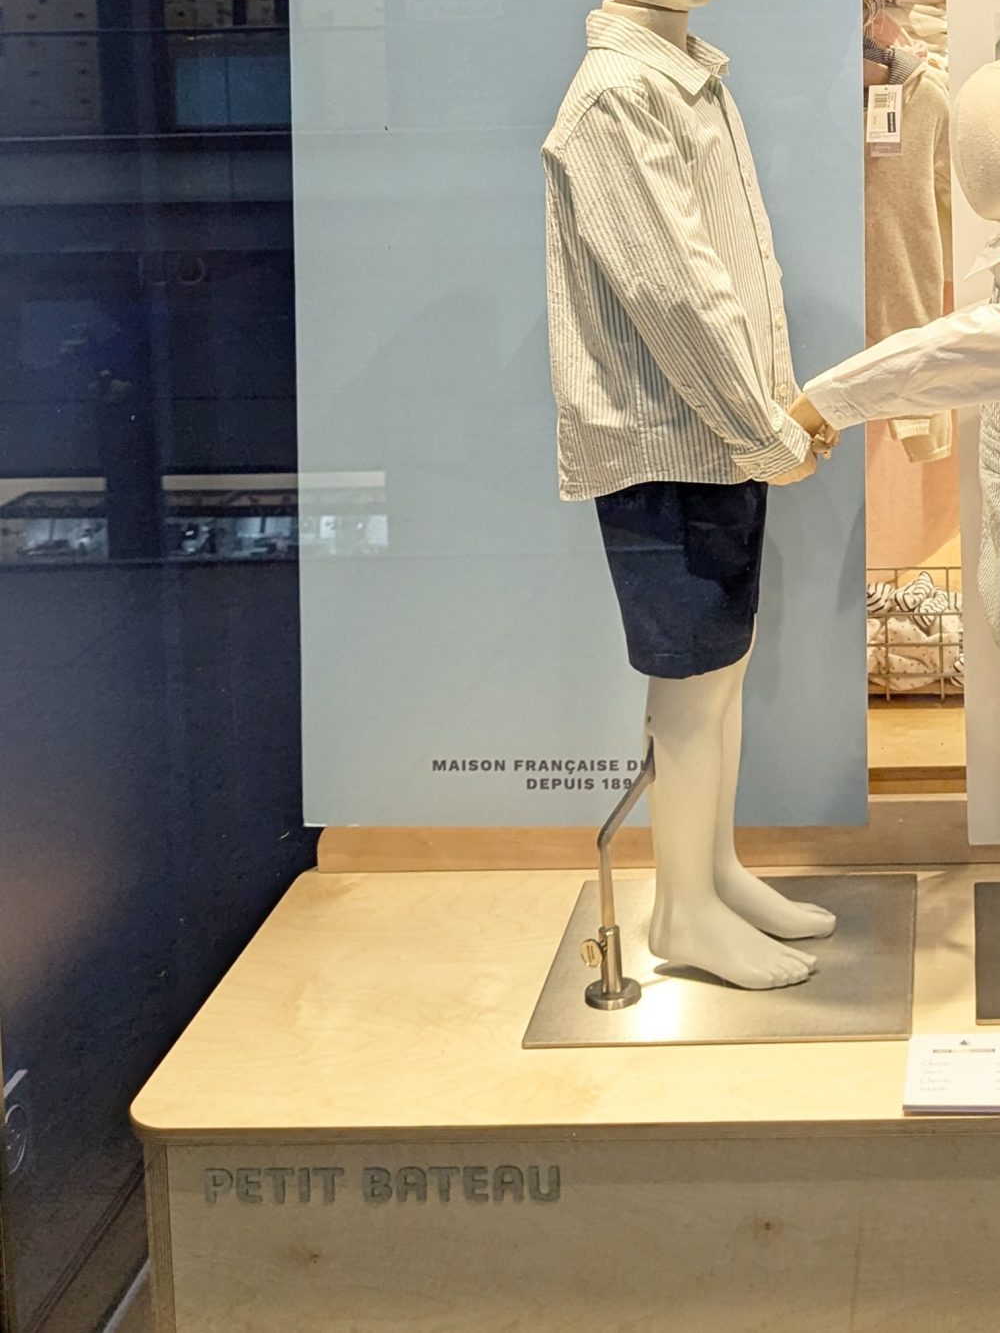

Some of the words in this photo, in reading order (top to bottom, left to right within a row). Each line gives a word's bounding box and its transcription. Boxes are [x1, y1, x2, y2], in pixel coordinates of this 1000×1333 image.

[432, 759, 506, 772] MAISON
[514, 759, 620, 775] FRANÇAISE
[526, 778, 595, 790] DEPUIS
[204, 1166, 345, 1205] PETIT
[362, 1165, 561, 1205] BATEAU
